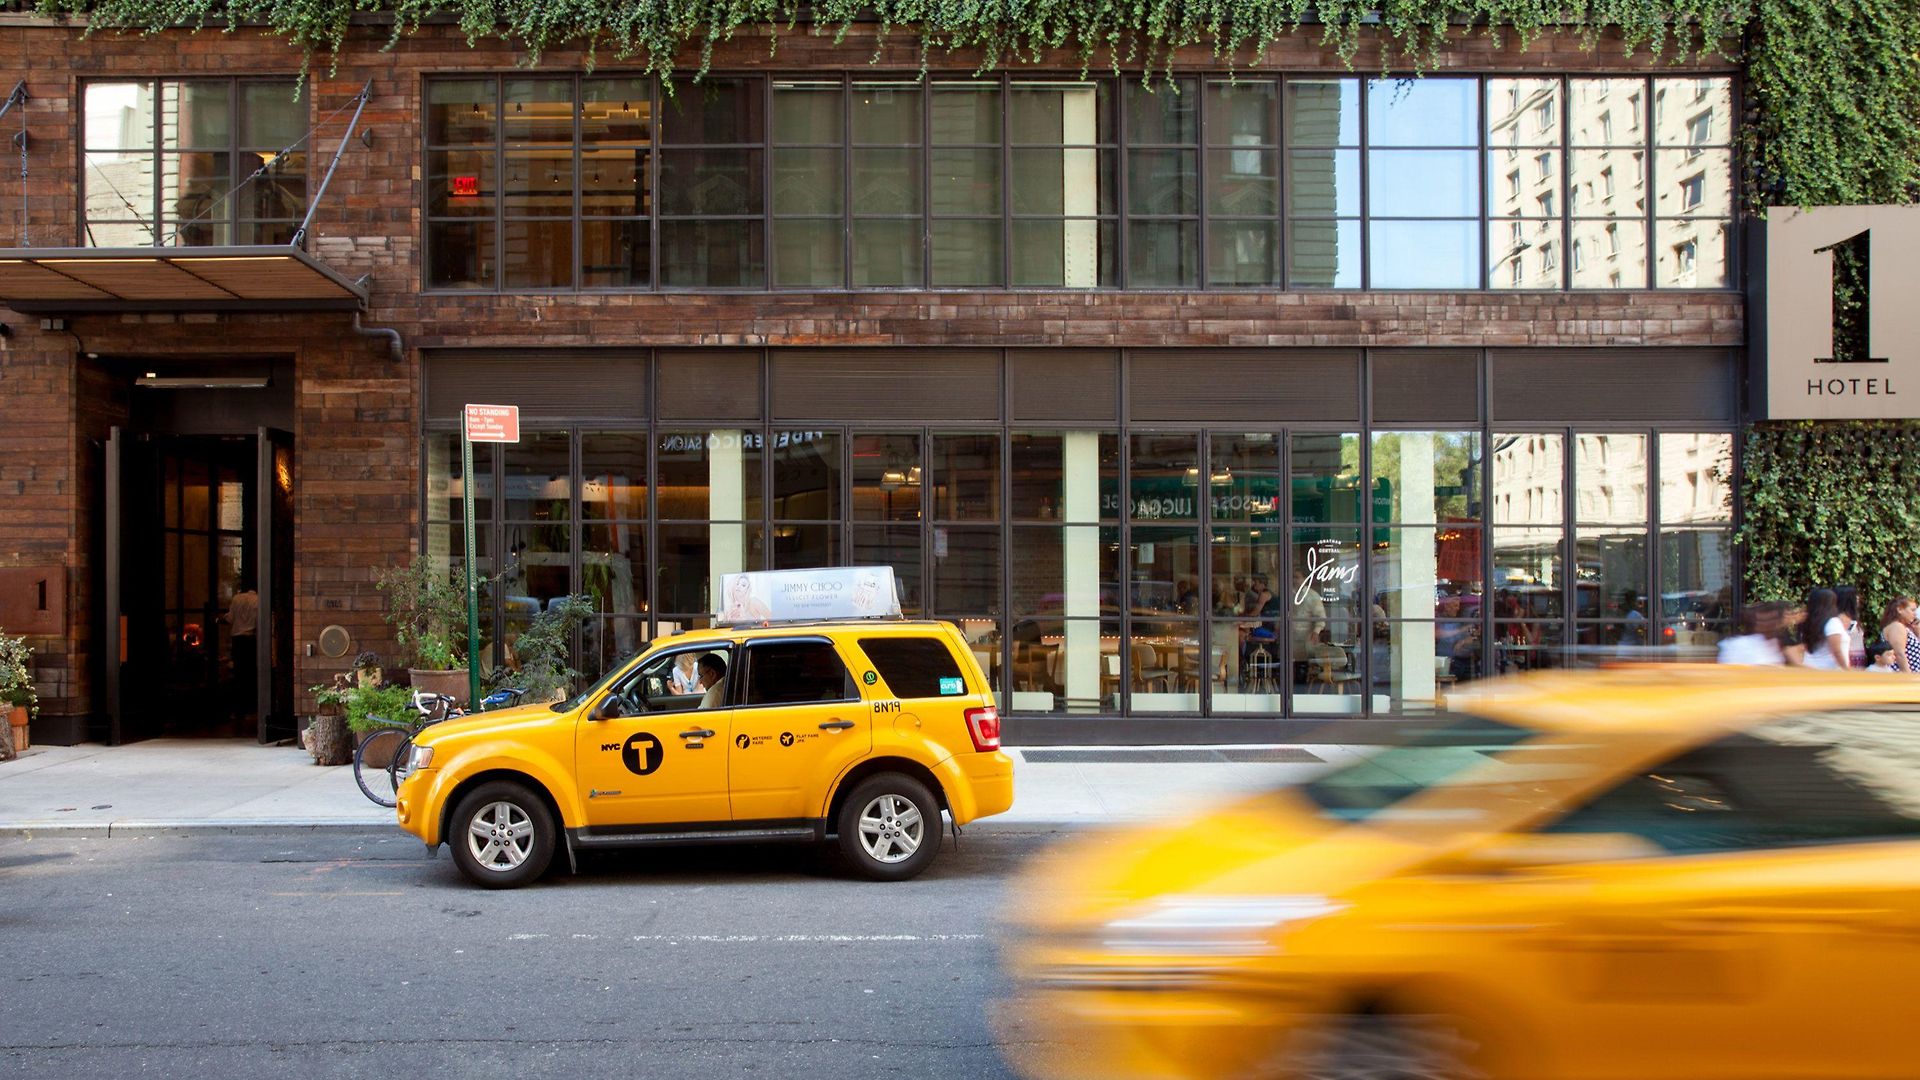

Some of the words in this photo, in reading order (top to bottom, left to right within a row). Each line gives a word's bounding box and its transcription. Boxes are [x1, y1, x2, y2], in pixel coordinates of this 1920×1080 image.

[1813, 228, 1889, 363] 1
[1807, 378, 1896, 395] HOTEL
[479, 408, 510, 416] STANDING
[1294, 547, 1359, 605] Jams
[781, 583, 808, 592] JIMMY
[810, 581, 843, 591] CHOO
[873, 701, 901, 713] 8N19
[601, 743, 620, 751] NYC
[630, 740, 654, 770] T
